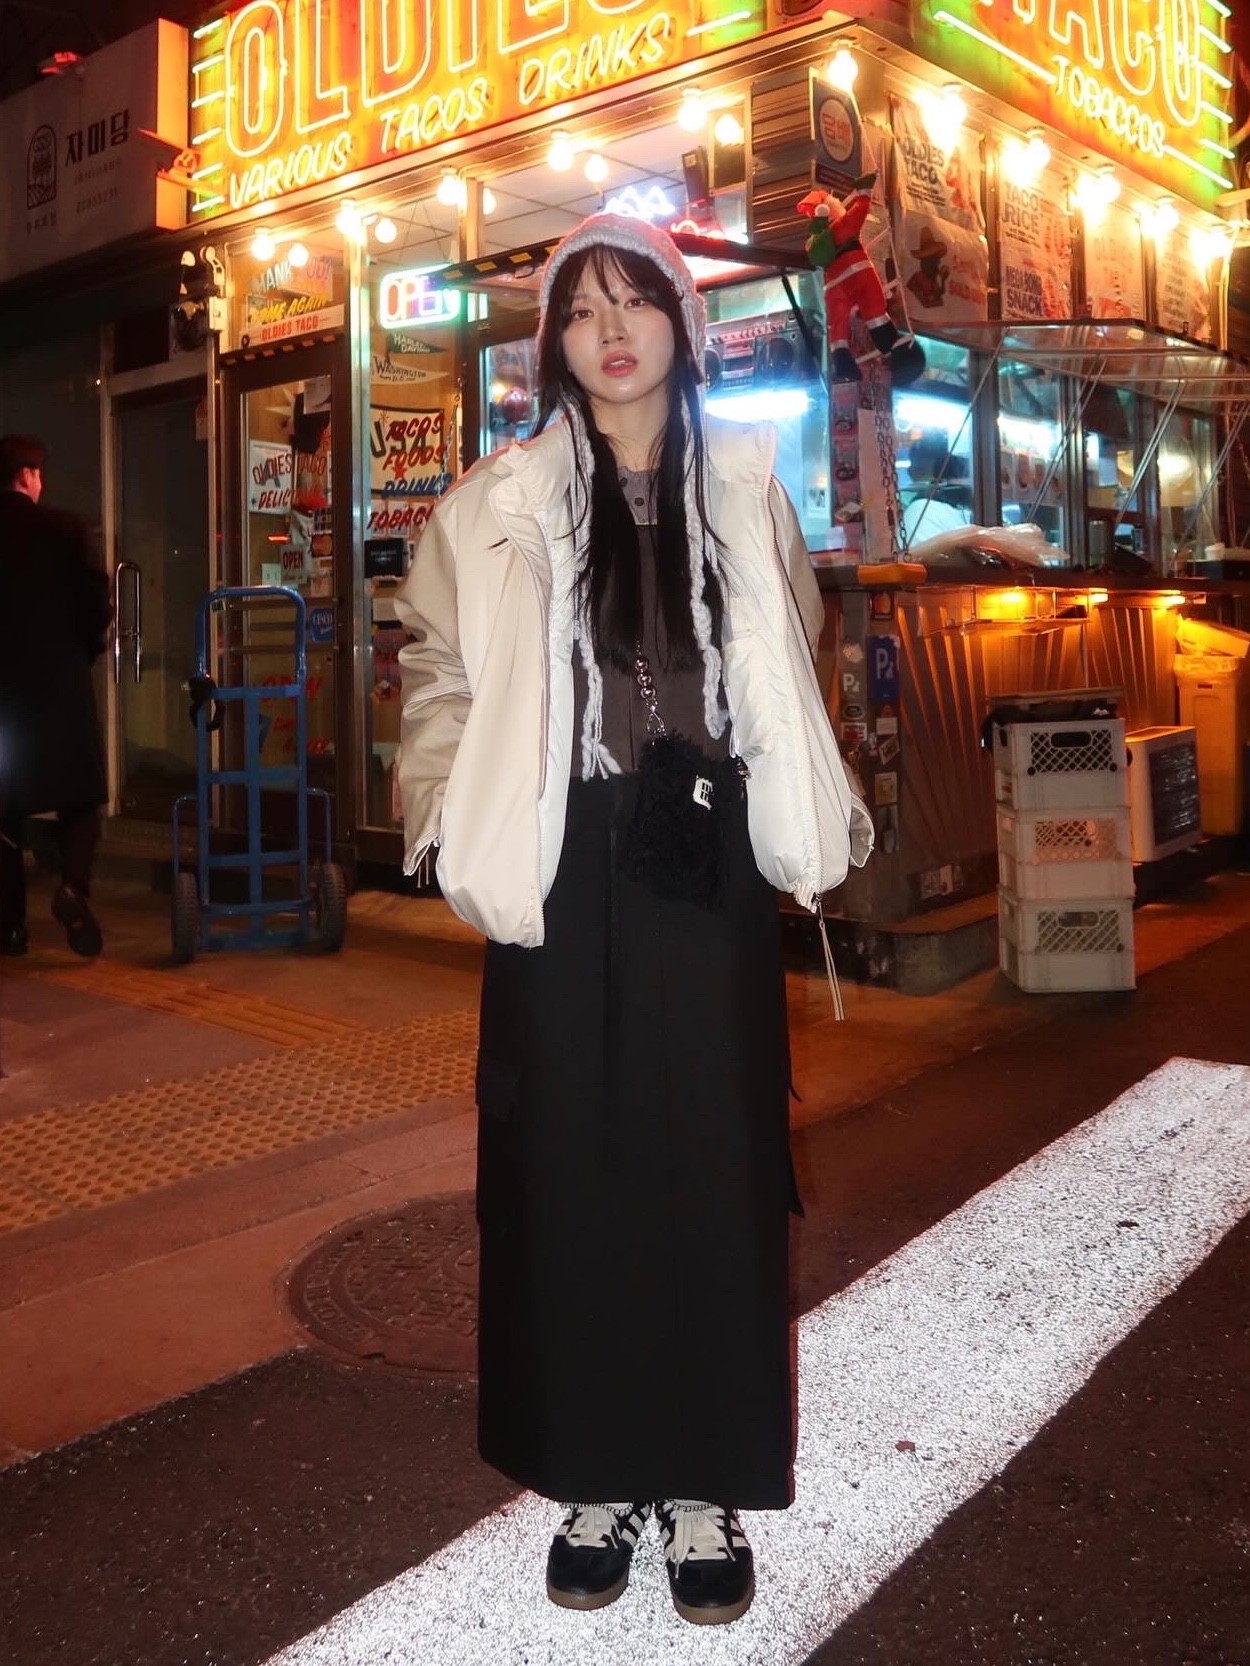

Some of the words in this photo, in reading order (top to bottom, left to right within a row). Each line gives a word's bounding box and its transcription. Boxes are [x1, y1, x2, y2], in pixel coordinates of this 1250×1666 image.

[226, 0, 646, 157] OLD
[1013, 0, 1200, 126] CO
[230, 131, 351, 209] VARIOUS
[380, 77, 489, 154] TACOS
[519, 11, 671, 106] DRINKS
[1052, 55, 1166, 158] TOBACCOS
[65, 108, 130, 168] 자미당
[905, 157, 940, 184] TACO
[1005, 182, 1039, 212] TACO
[262, 321, 293, 341] OLDIES
[295, 314, 320, 332] TACO
[282, 551, 304, 571] OPEN
